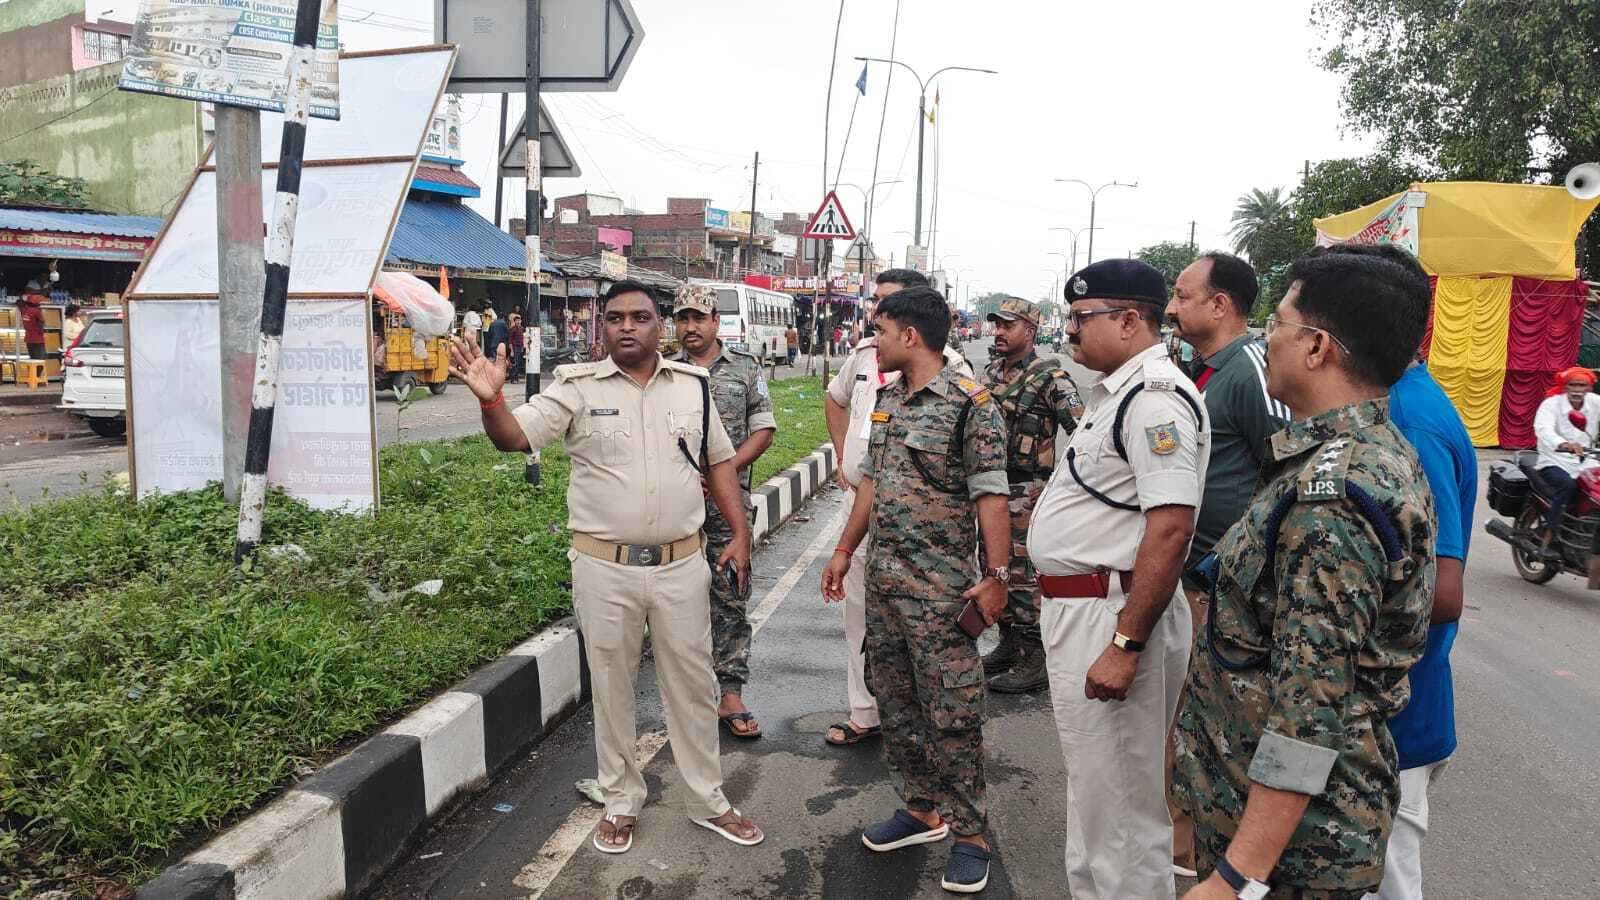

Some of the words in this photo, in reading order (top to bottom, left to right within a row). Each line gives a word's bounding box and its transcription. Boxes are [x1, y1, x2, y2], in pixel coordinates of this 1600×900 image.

[219, 0, 250, 9] DUMKA
[252, 1, 296, 16] (JHARKHA
[1304, 480, 1339, 495] J.P.S.
